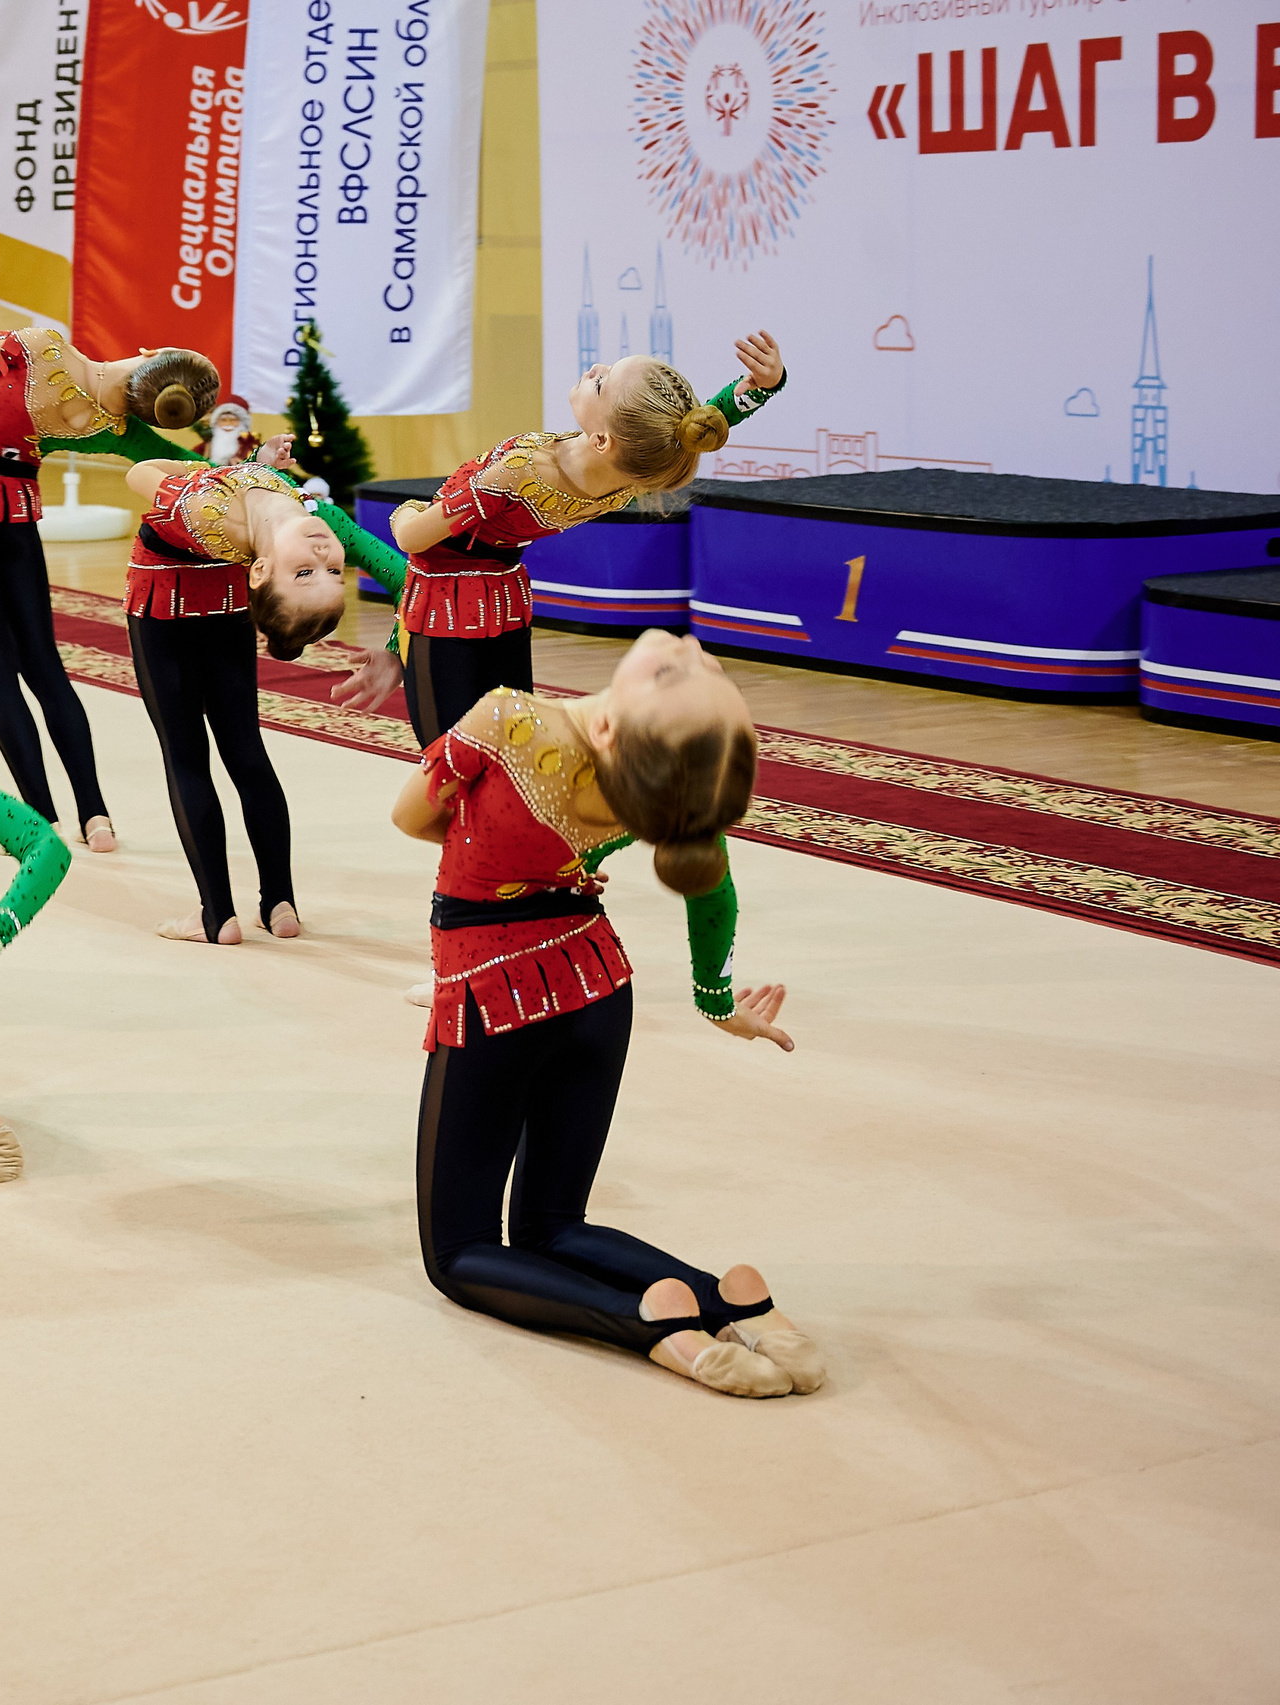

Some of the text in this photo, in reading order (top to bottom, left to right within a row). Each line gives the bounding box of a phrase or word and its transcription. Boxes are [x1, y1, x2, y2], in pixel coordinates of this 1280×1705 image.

[15, 99, 42, 213] ФОНД
[53, 0, 82, 211] ПРЕЗИДЕН
[171, 65, 216, 310] Специальная
[205, 66, 245, 277] Олимпиада
[337, 28, 379, 224] ВФСЛСИН
[867, 36, 1123, 155] «ШАГ
[1157, 30, 1216, 144] В
[384, 82, 428, 312] Самарской
[390, 326, 412, 343] в
[834, 554, 866, 622] 1
